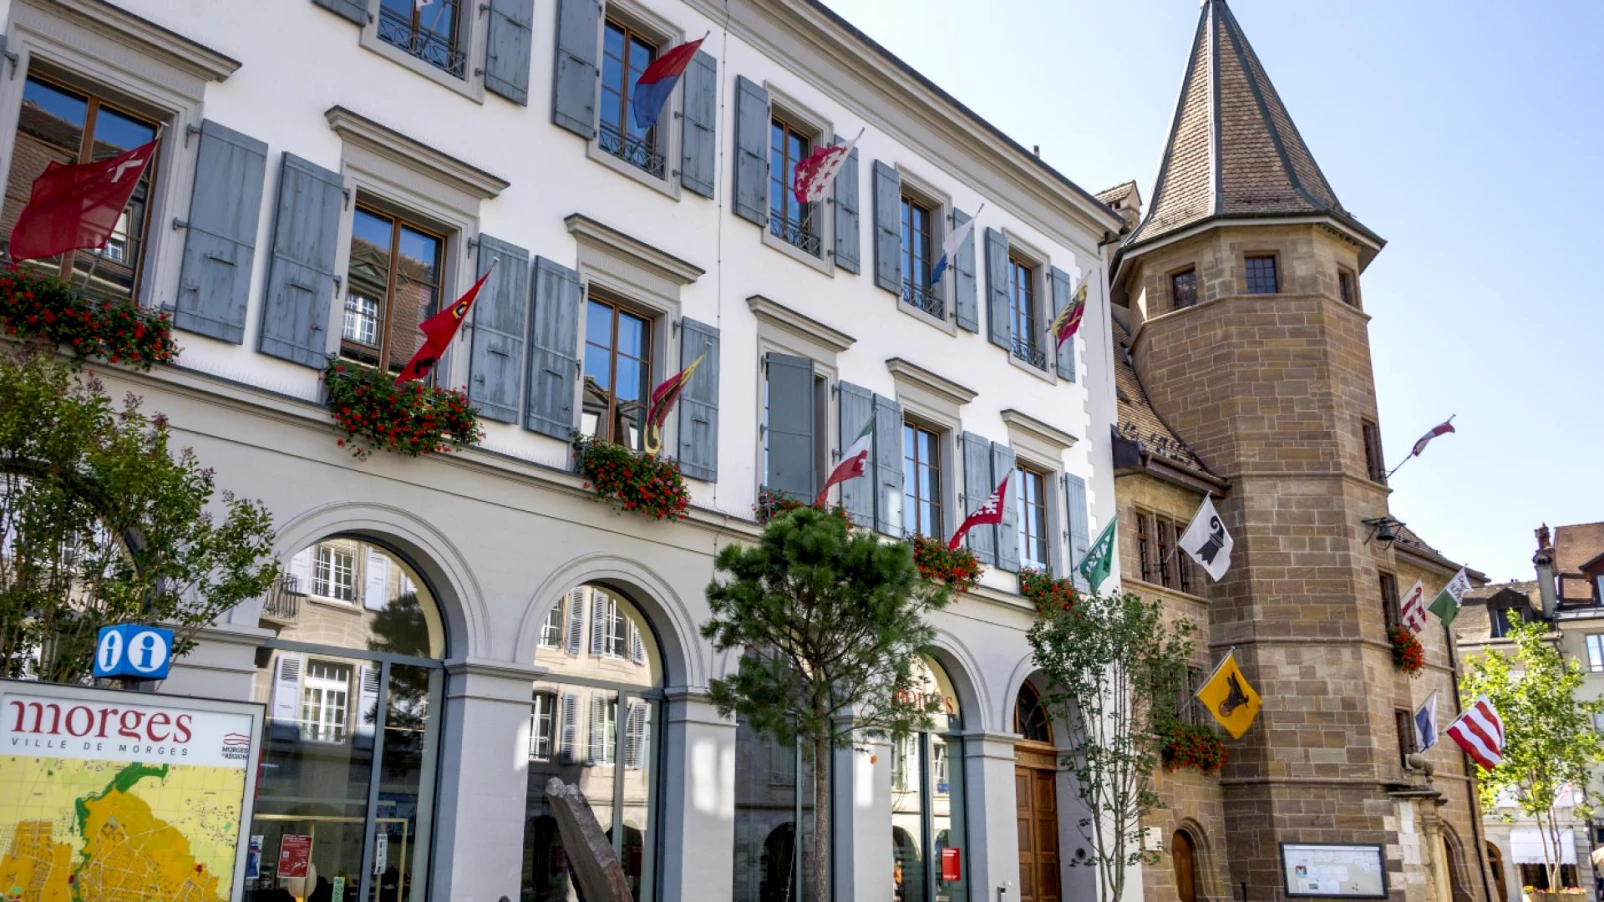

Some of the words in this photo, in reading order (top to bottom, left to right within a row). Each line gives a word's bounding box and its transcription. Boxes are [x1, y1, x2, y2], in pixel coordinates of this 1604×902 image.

[9, 700, 193, 744] morges
[11, 738, 67, 749] VILLE
[83, 742, 103, 751] DE
[118, 744, 188, 756] MORGES
